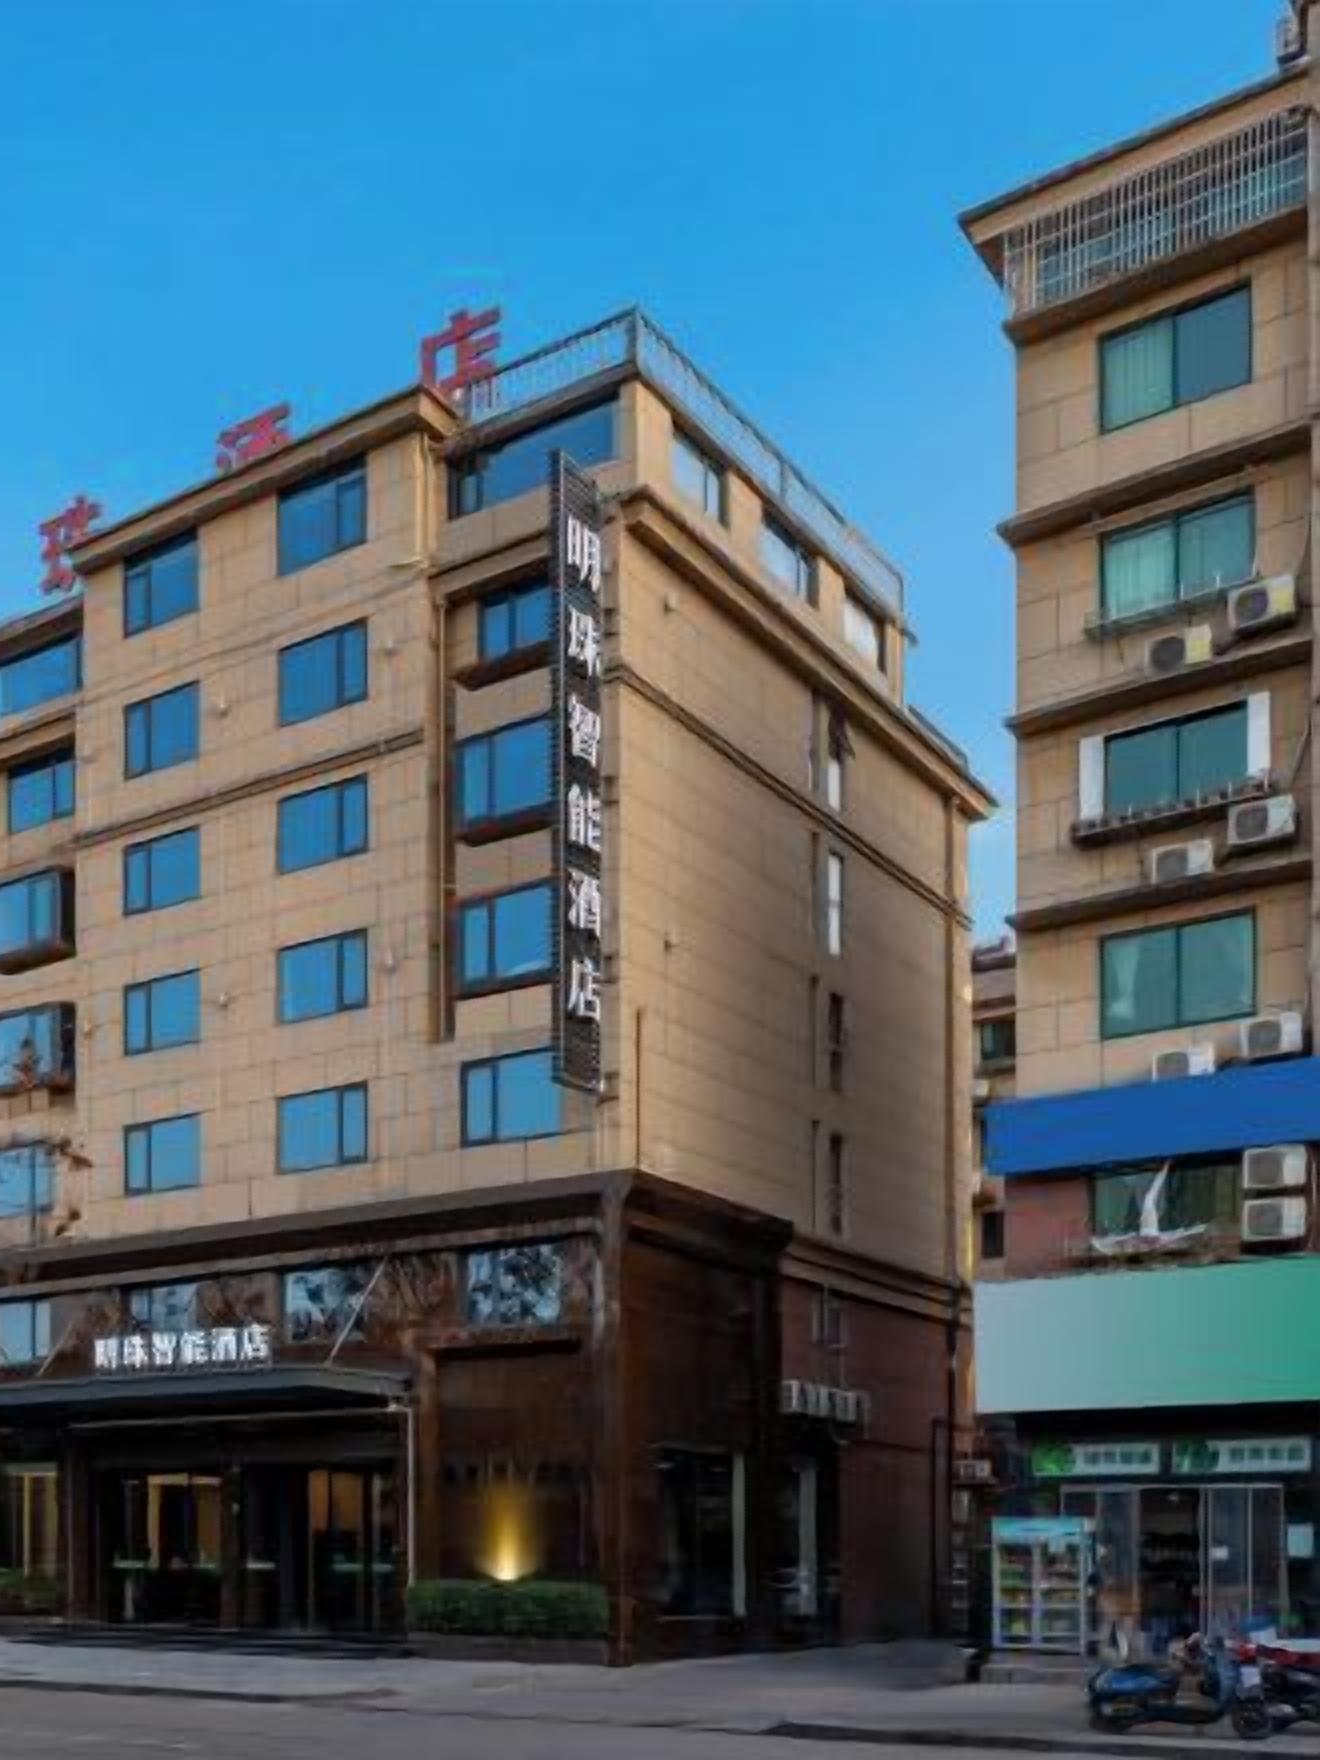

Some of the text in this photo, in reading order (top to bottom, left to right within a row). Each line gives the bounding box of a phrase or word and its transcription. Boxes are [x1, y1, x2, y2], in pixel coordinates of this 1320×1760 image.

[566, 515, 601, 1020] 明珠智能酒店
